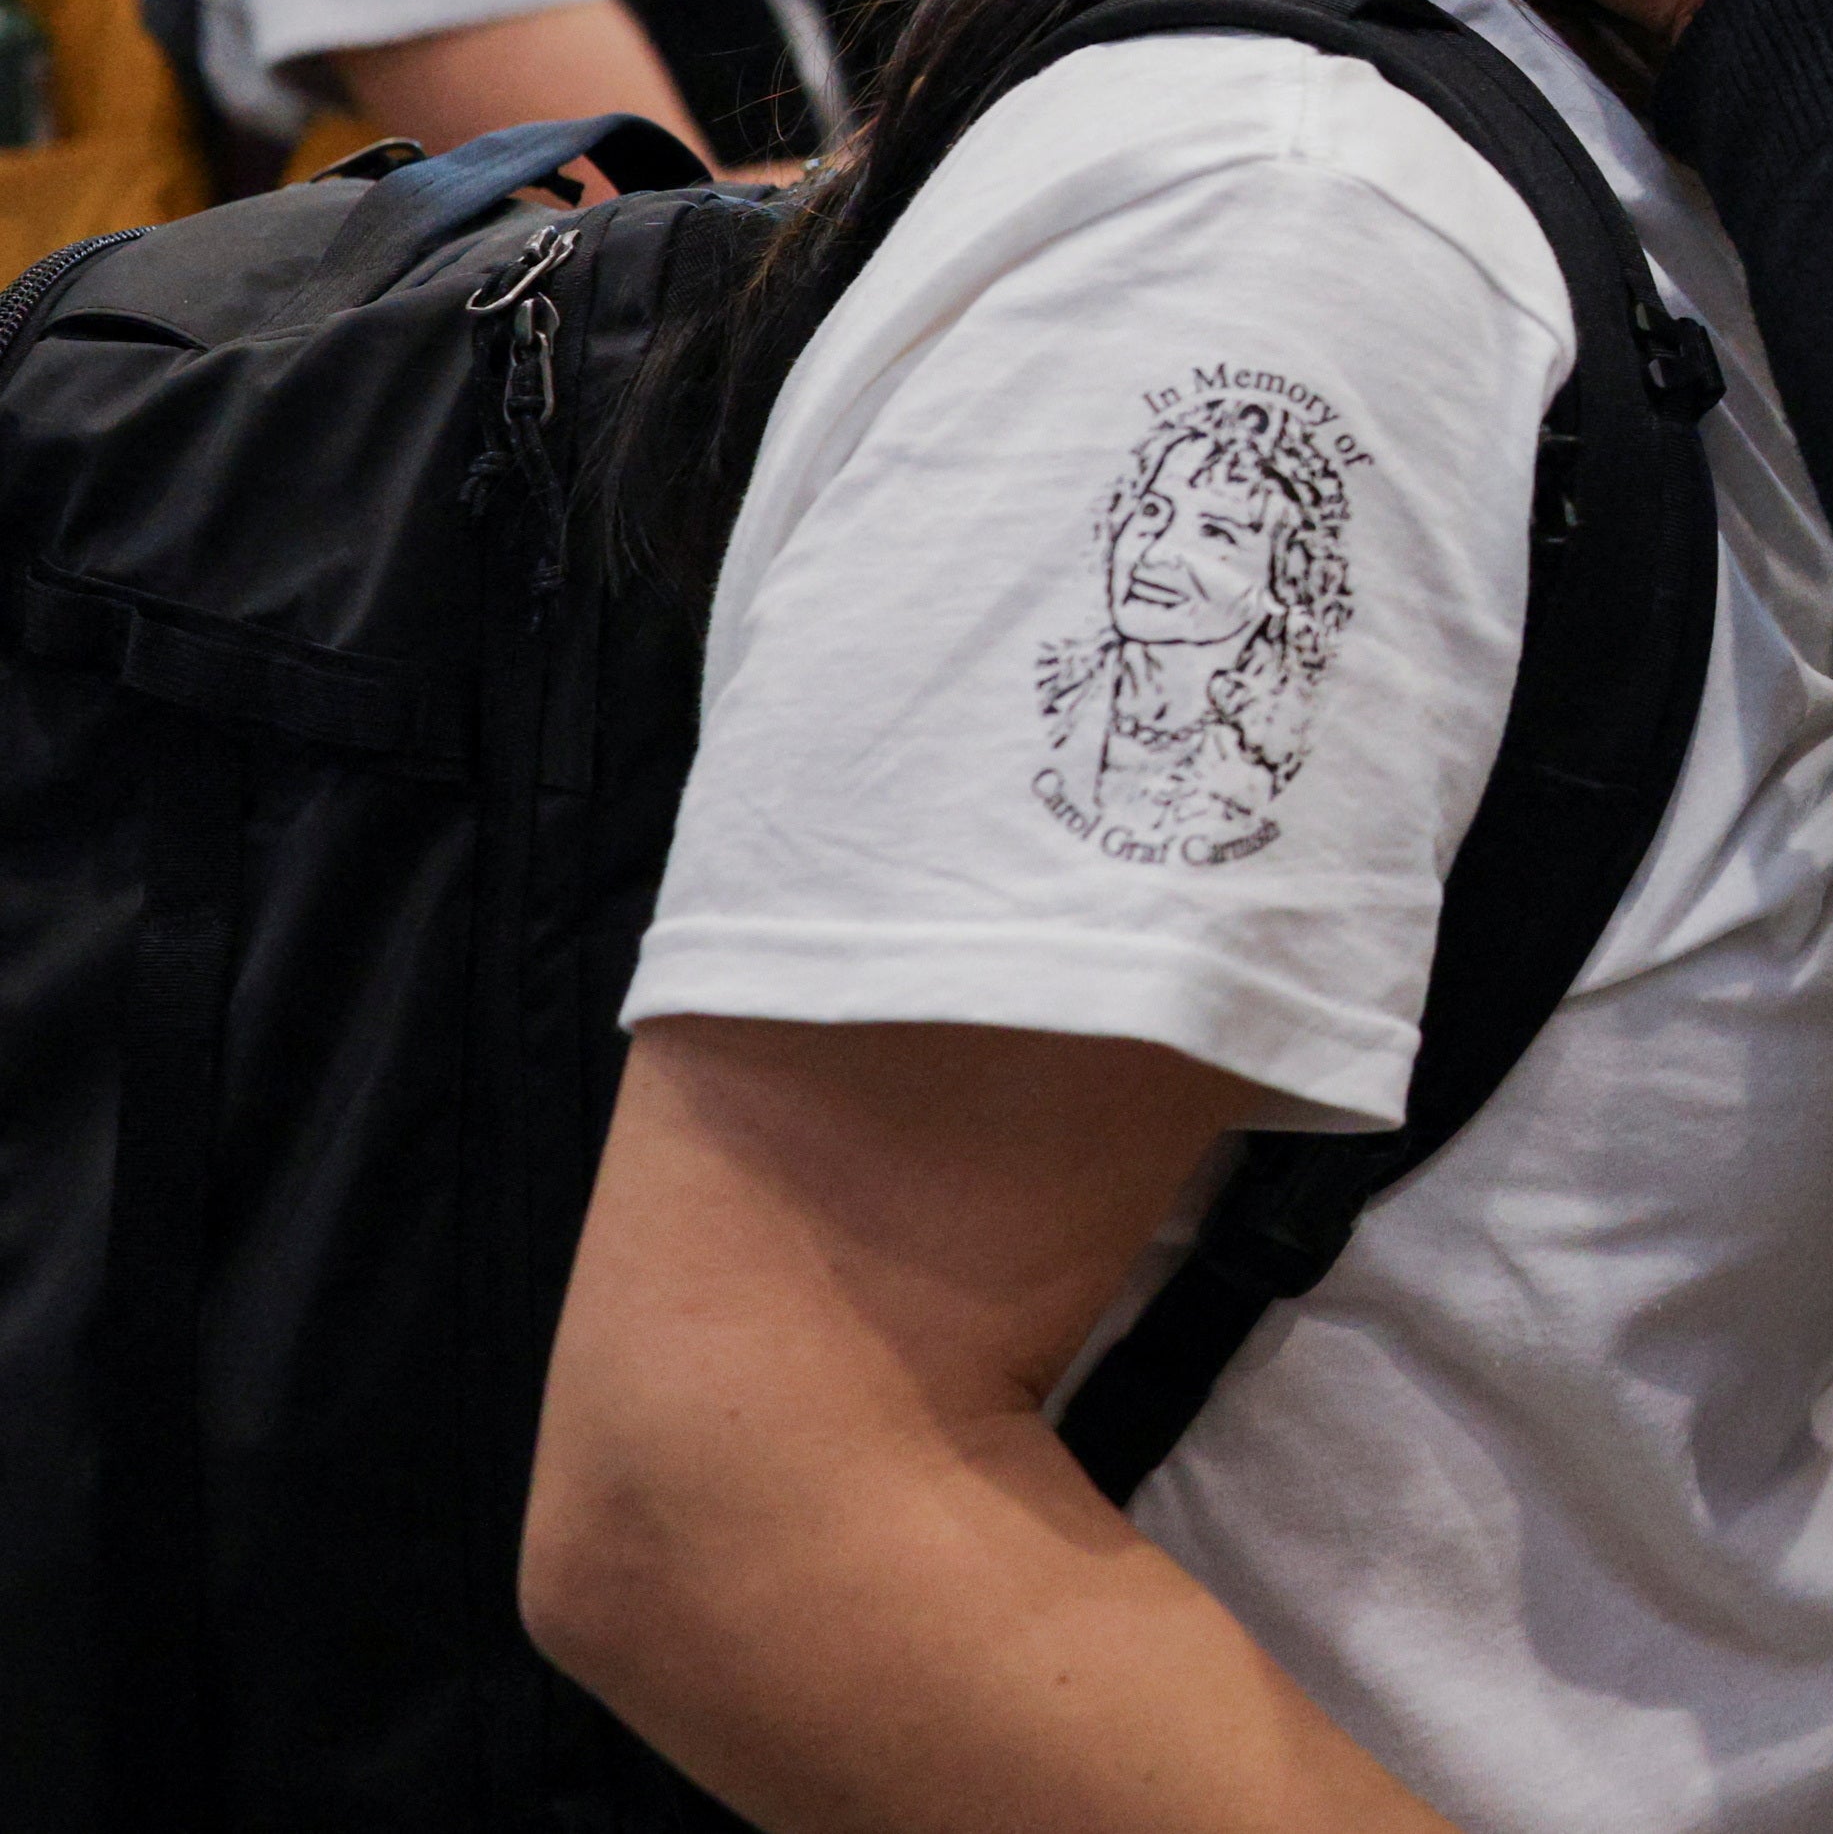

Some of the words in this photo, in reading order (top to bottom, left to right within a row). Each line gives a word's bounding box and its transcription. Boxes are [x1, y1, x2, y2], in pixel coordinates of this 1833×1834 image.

[1143, 386, 1182, 415] In
[1192, 362, 1340, 426] Memory
[1334, 433, 1375, 467] of
[1031, 767, 1102, 842] Carol
[1102, 825, 1177, 864] Graf
